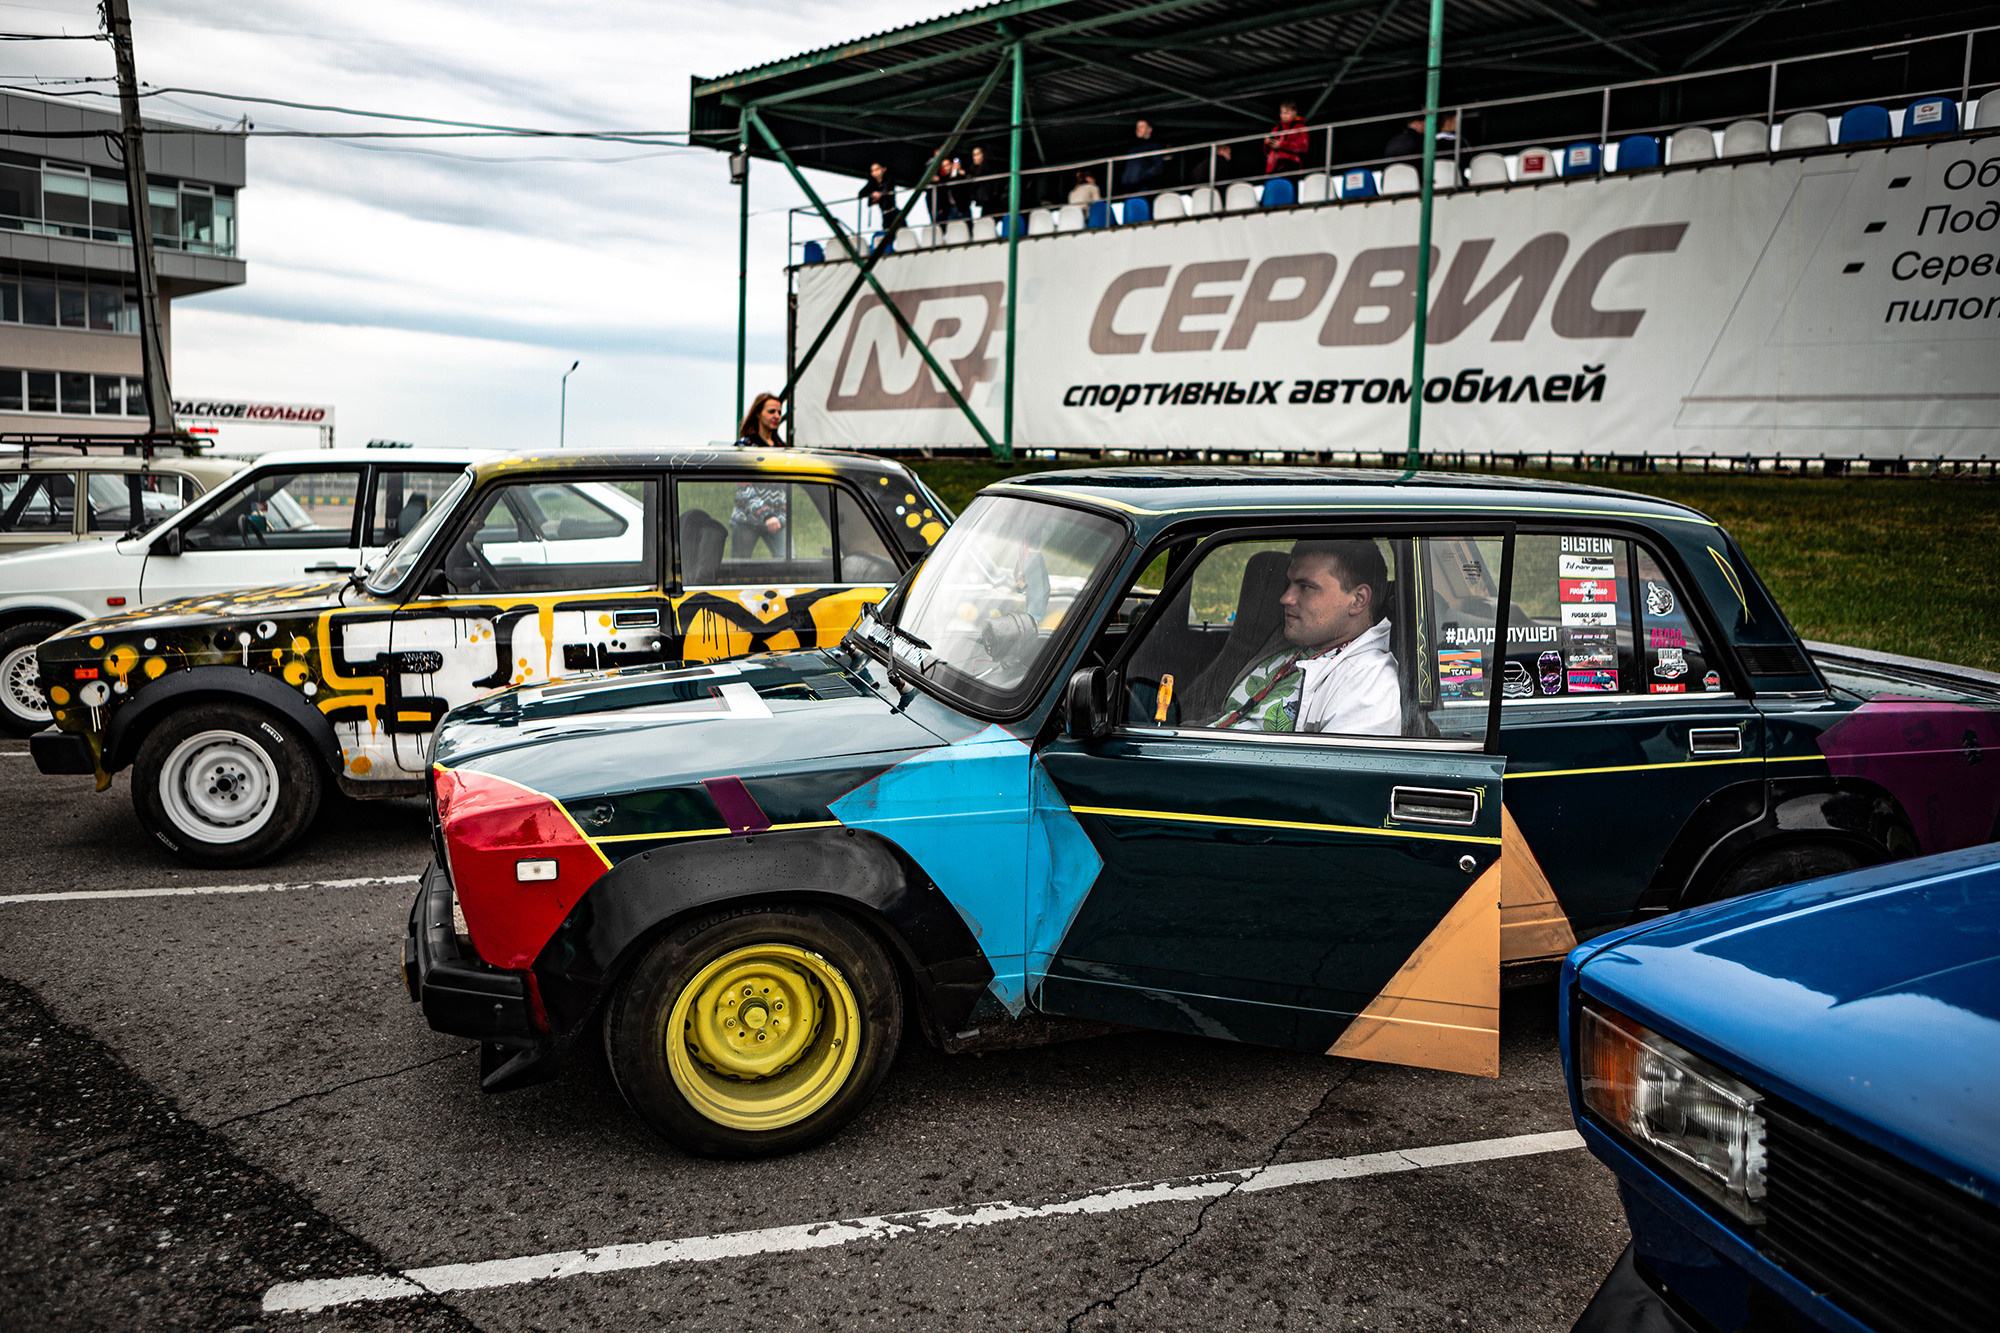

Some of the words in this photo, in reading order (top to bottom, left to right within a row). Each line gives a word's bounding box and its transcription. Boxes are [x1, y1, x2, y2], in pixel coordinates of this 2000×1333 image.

[1892, 251, 2000, 285] Серв
[1088, 222, 1689, 354] СЕРВИС
[1063, 380, 1283, 412] спортивных
[1289, 363, 1608, 406] автомобилей
[1561, 536, 1613, 553] BILSTEIN
[1446, 626, 1557, 646] #ДАЛДЛУШЕЛ
[1651, 638, 1687, 647] КАСТОМ
